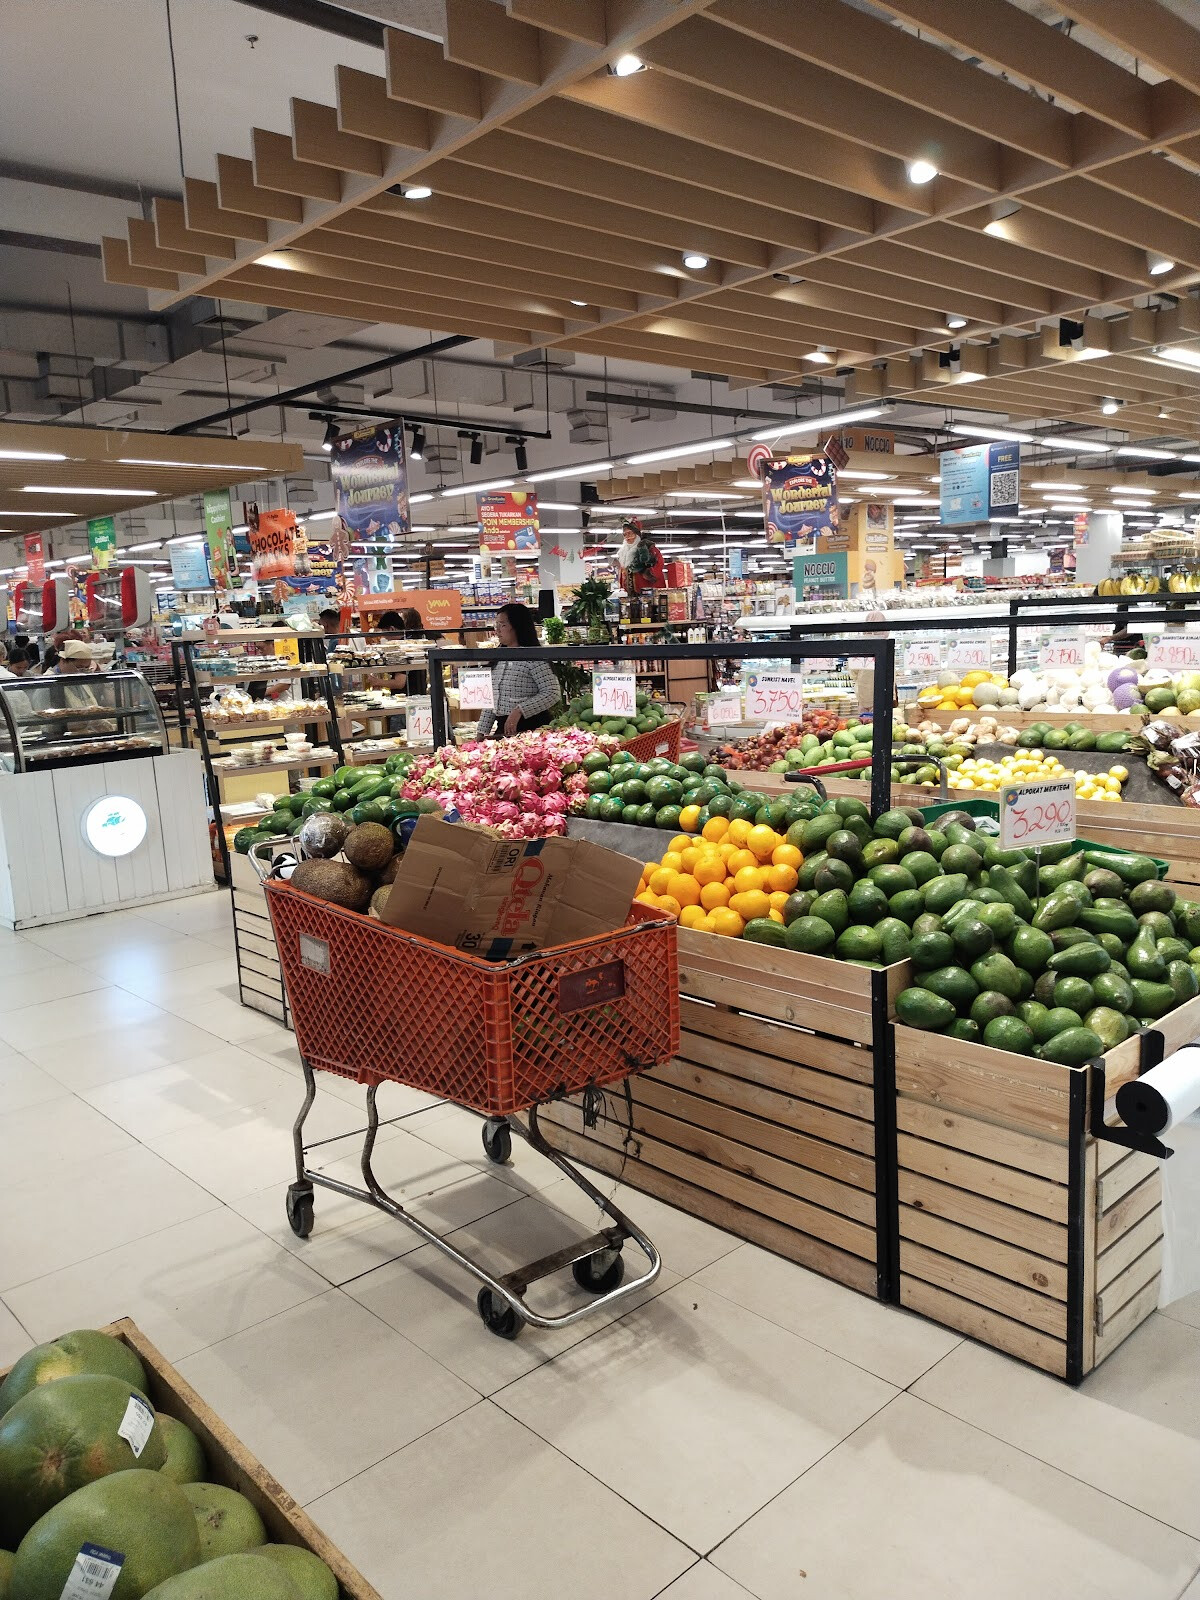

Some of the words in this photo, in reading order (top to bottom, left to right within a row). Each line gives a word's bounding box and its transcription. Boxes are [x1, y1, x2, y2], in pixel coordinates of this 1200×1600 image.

[864, 435, 890, 454] NOCCIO
[997, 454, 1013, 463] FREE
[348, 484, 394, 507] Journey
[770, 483, 832, 502] Wonderful
[779, 498, 828, 514] Journey
[482, 518, 498, 526] POIN
[499, 518, 535, 526] MEMBERSHIP
[483, 526, 499, 534] Anda
[803, 561, 837, 578] NOCCIO
[427, 599, 451, 608] YAVA
[1018, 787, 1043, 796] ALPOKAT
[1043, 784, 1070, 793] MENTEGA
[503, 848, 520, 867] ORI
[500, 856, 545, 937] Qtela
[531, 903, 543, 927] Ringan
[461, 932, 481, 949] 30
